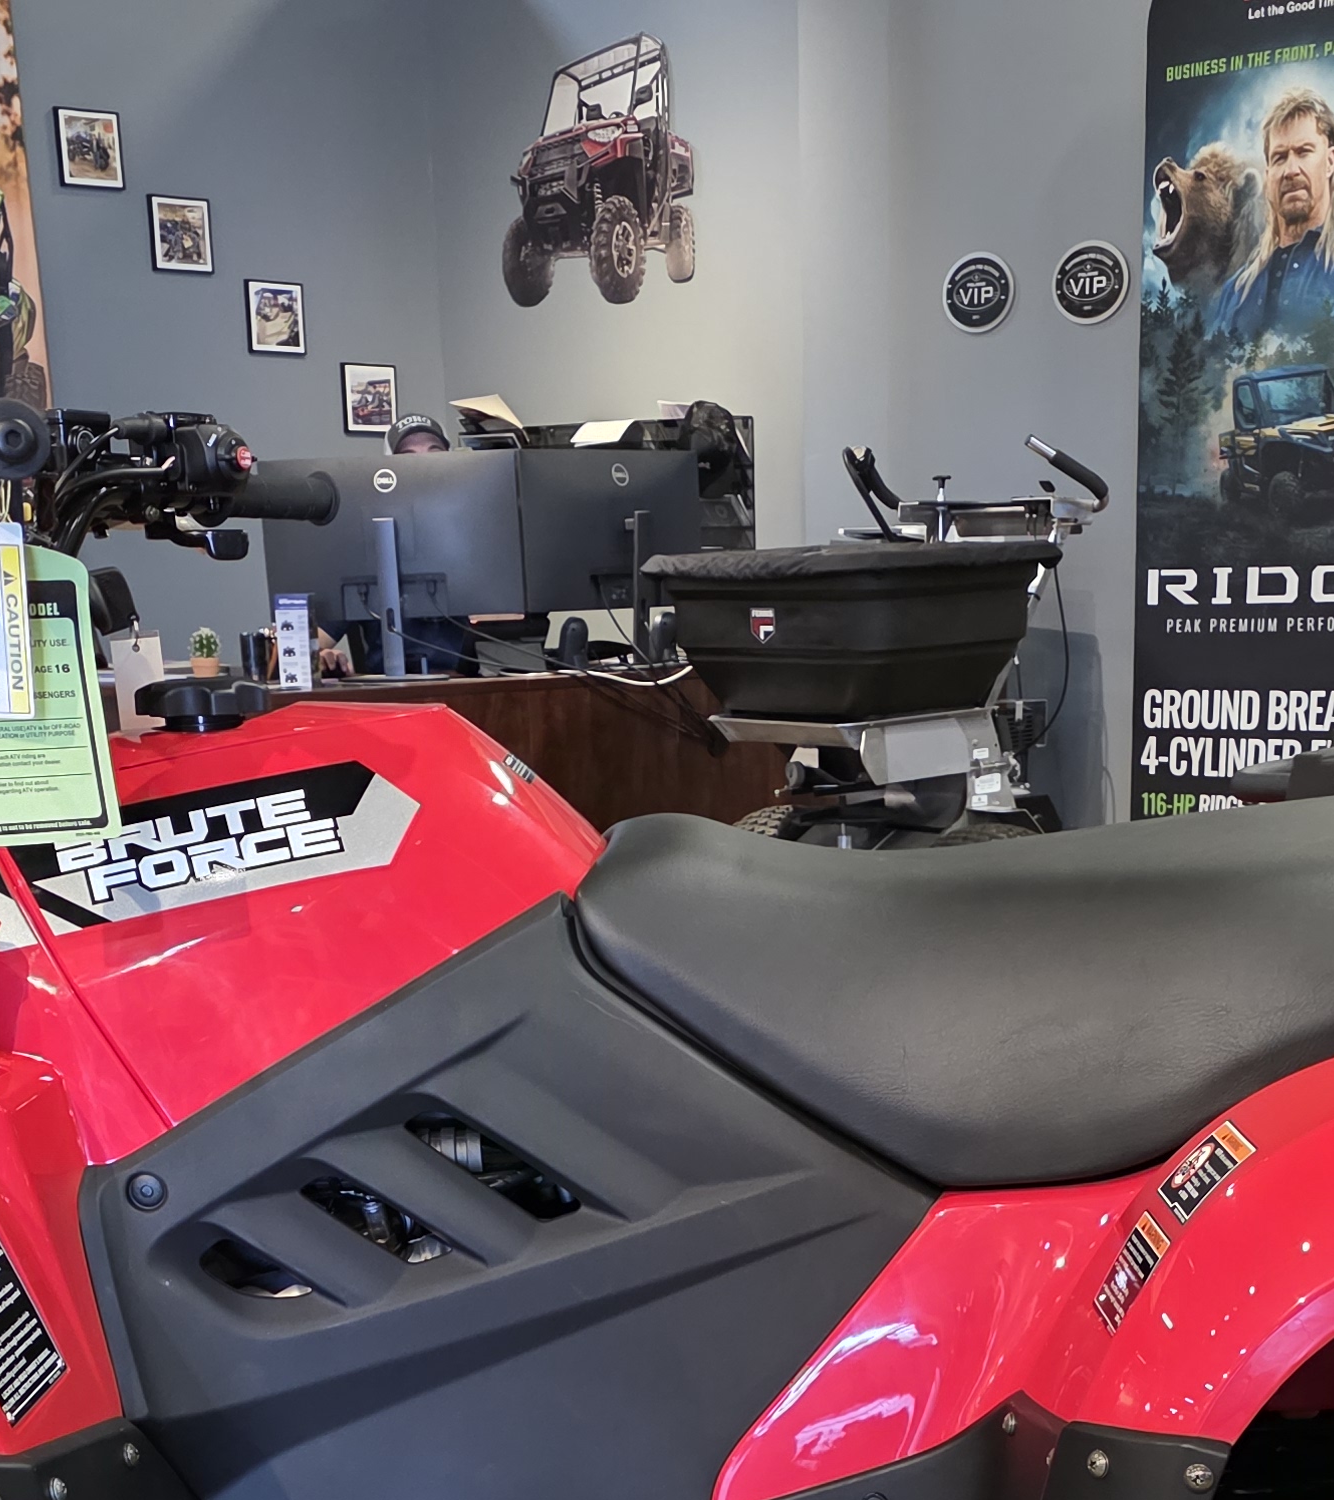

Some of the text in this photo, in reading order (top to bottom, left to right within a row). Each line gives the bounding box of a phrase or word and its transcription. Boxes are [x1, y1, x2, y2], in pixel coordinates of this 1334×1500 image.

[1247, 7, 1266, 20] Let
[1267, 4, 1285, 18] the
[1286, 0, 1316, 14] Good
[1166, 58, 1227, 82] BUSINESS
[1230, 54, 1244, 70] IN
[1247, 50, 1272, 69] THE
[1274, 43, 1320, 65] FRONT.
[959, 286, 994, 305] VIP
[1069, 276, 1107, 296] VIP
[30, 602, 60, 616] ODEL
[1166, 618, 1202, 633] PEAK
[1209, 617, 1278, 633] PREMIUM
[6, 594, 24, 691] CAUTION
[34, 663, 71, 674] AGE 16
[34, 690, 76, 700] SSENGERS
[1143, 689, 1261, 731] GROUND
[1141, 792, 1245, 816] 116-HP RIDG
[54, 789, 311, 872] BRUTE
[91, 818, 343, 902] FORCE
